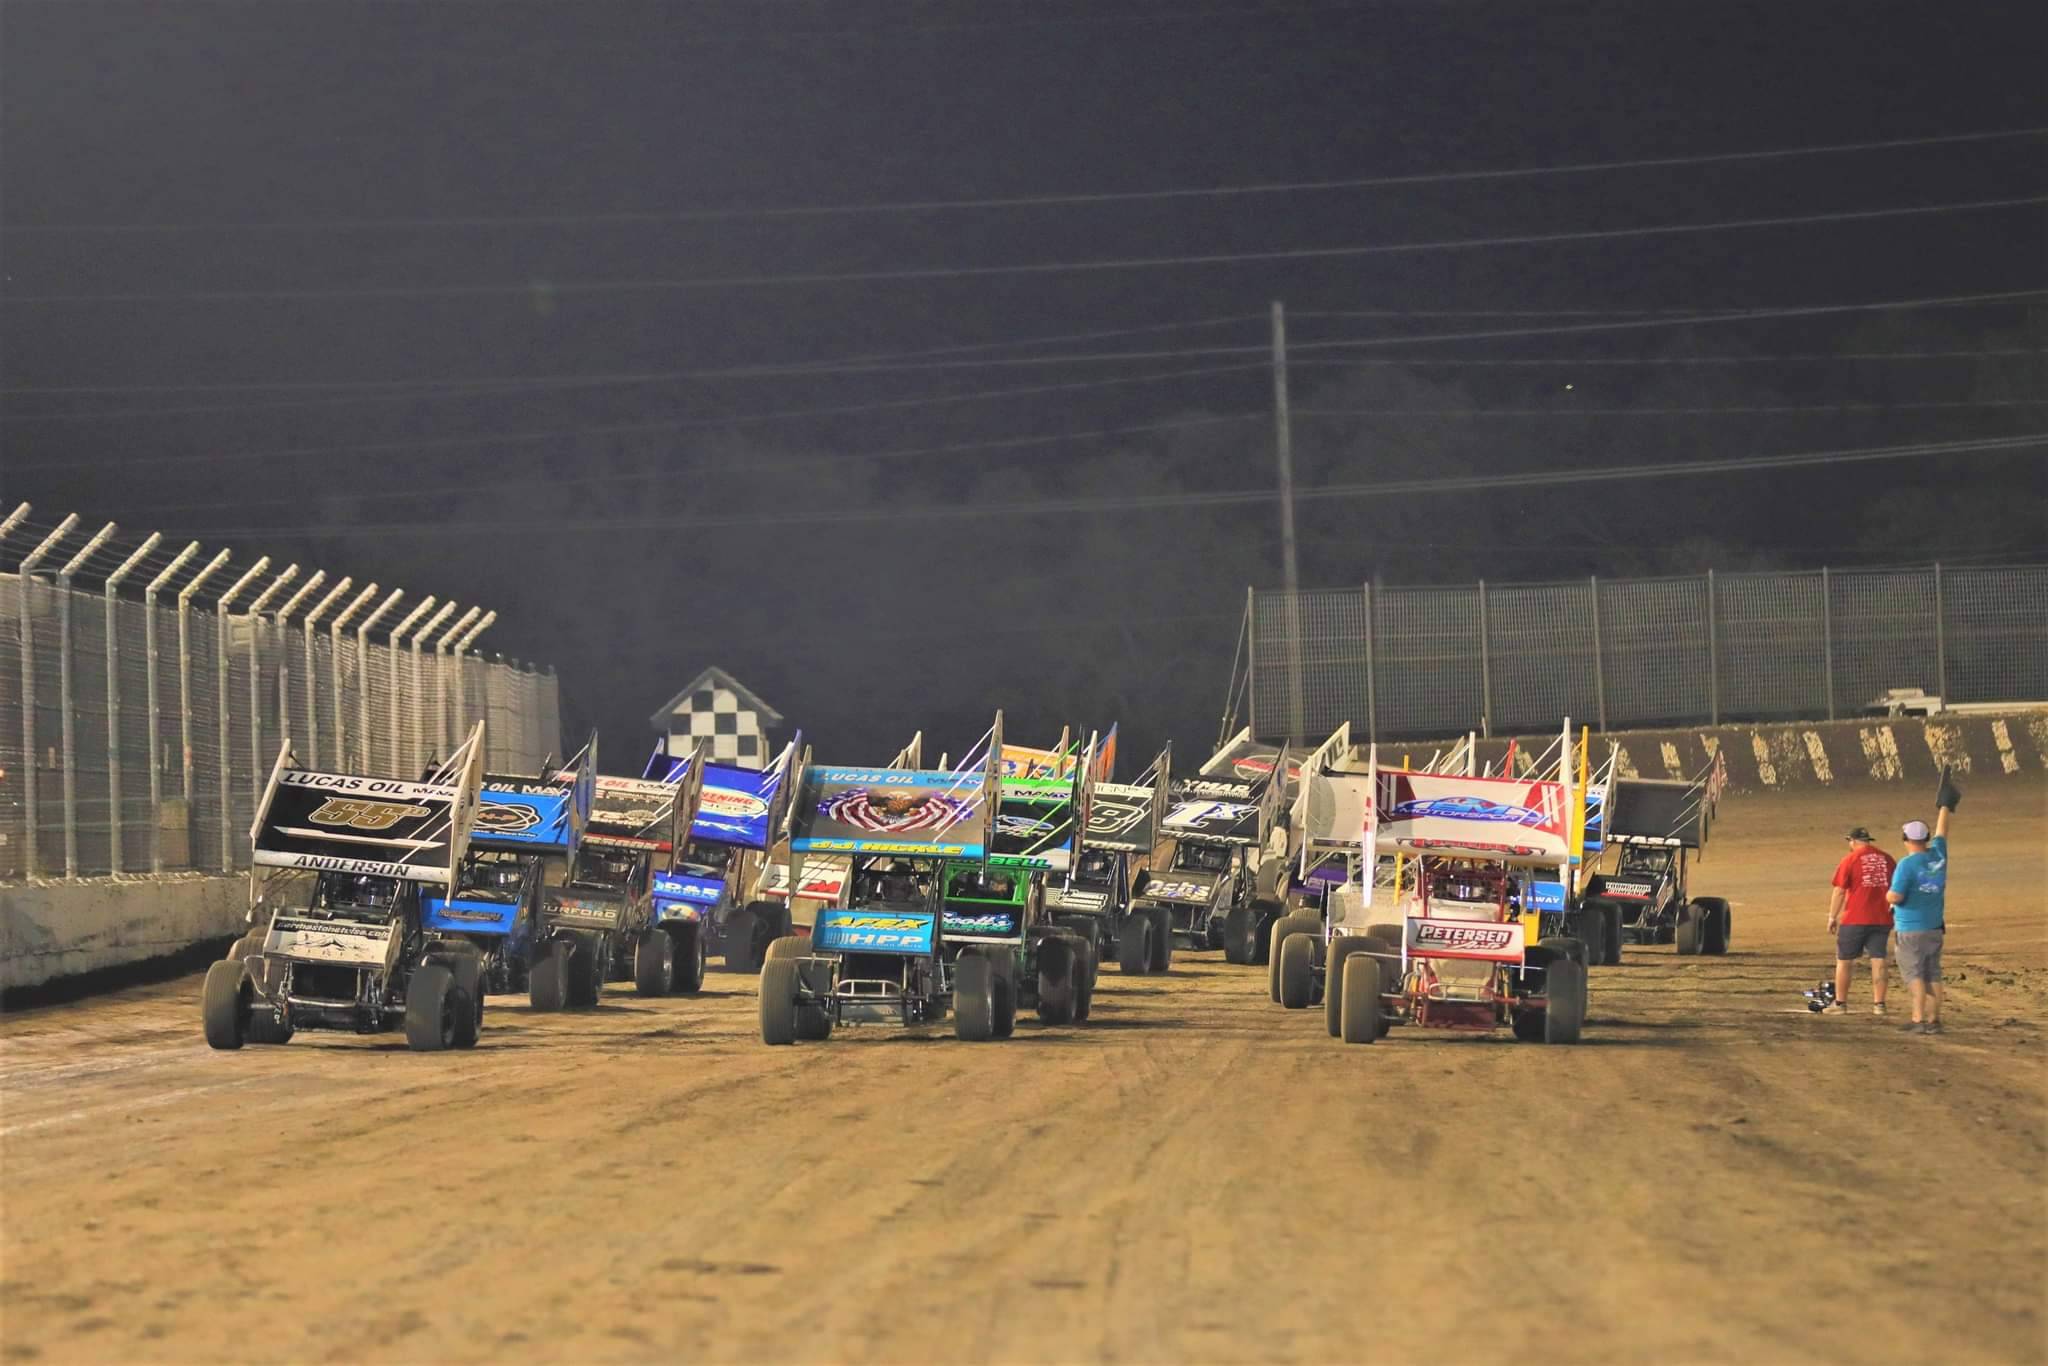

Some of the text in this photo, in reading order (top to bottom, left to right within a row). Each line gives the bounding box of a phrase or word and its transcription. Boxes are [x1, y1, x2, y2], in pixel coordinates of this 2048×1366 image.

[284, 773, 362, 790] LUCAS
[367, 782, 404, 794] OIL
[822, 772, 882, 783] LUCAS
[885, 775, 914, 784] OIL
[489, 782, 515, 793] OIL
[294, 855, 411, 877] ANDERSON
[849, 934, 924, 945] HPP
[1418, 925, 1512, 943] PETERSEN
